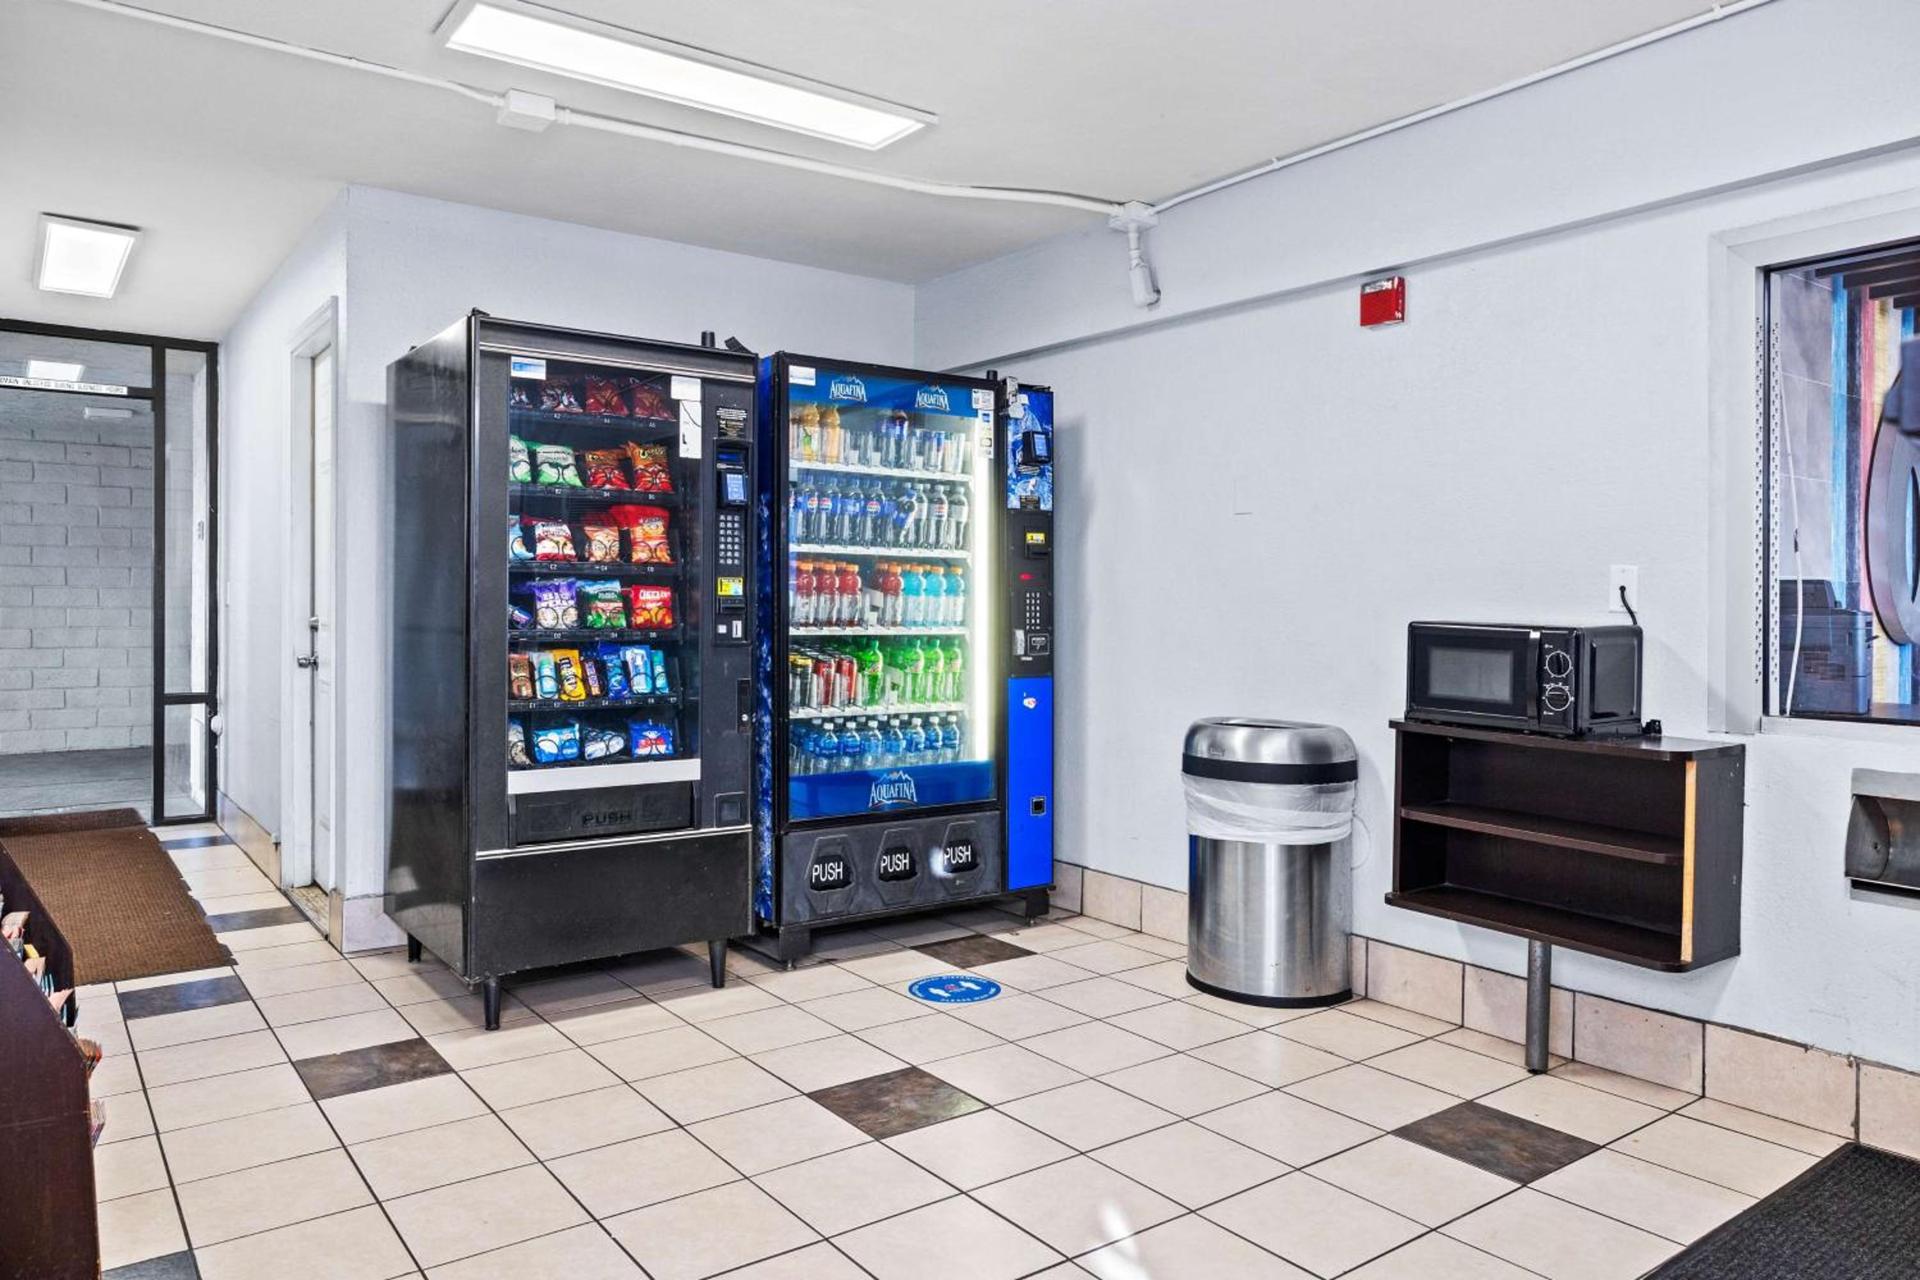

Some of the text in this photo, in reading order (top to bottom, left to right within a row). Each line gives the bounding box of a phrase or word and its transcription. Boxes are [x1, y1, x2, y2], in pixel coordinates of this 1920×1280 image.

[829, 380, 868, 402] AQUAFINA
[914, 388, 951, 411] AQUAFINA
[869, 777, 918, 808] AQUAFINA
[581, 809, 632, 827] PUSH
[880, 852, 910, 874] PUSH
[943, 844, 972, 865] PUSH
[812, 861, 844, 883] PUSH
